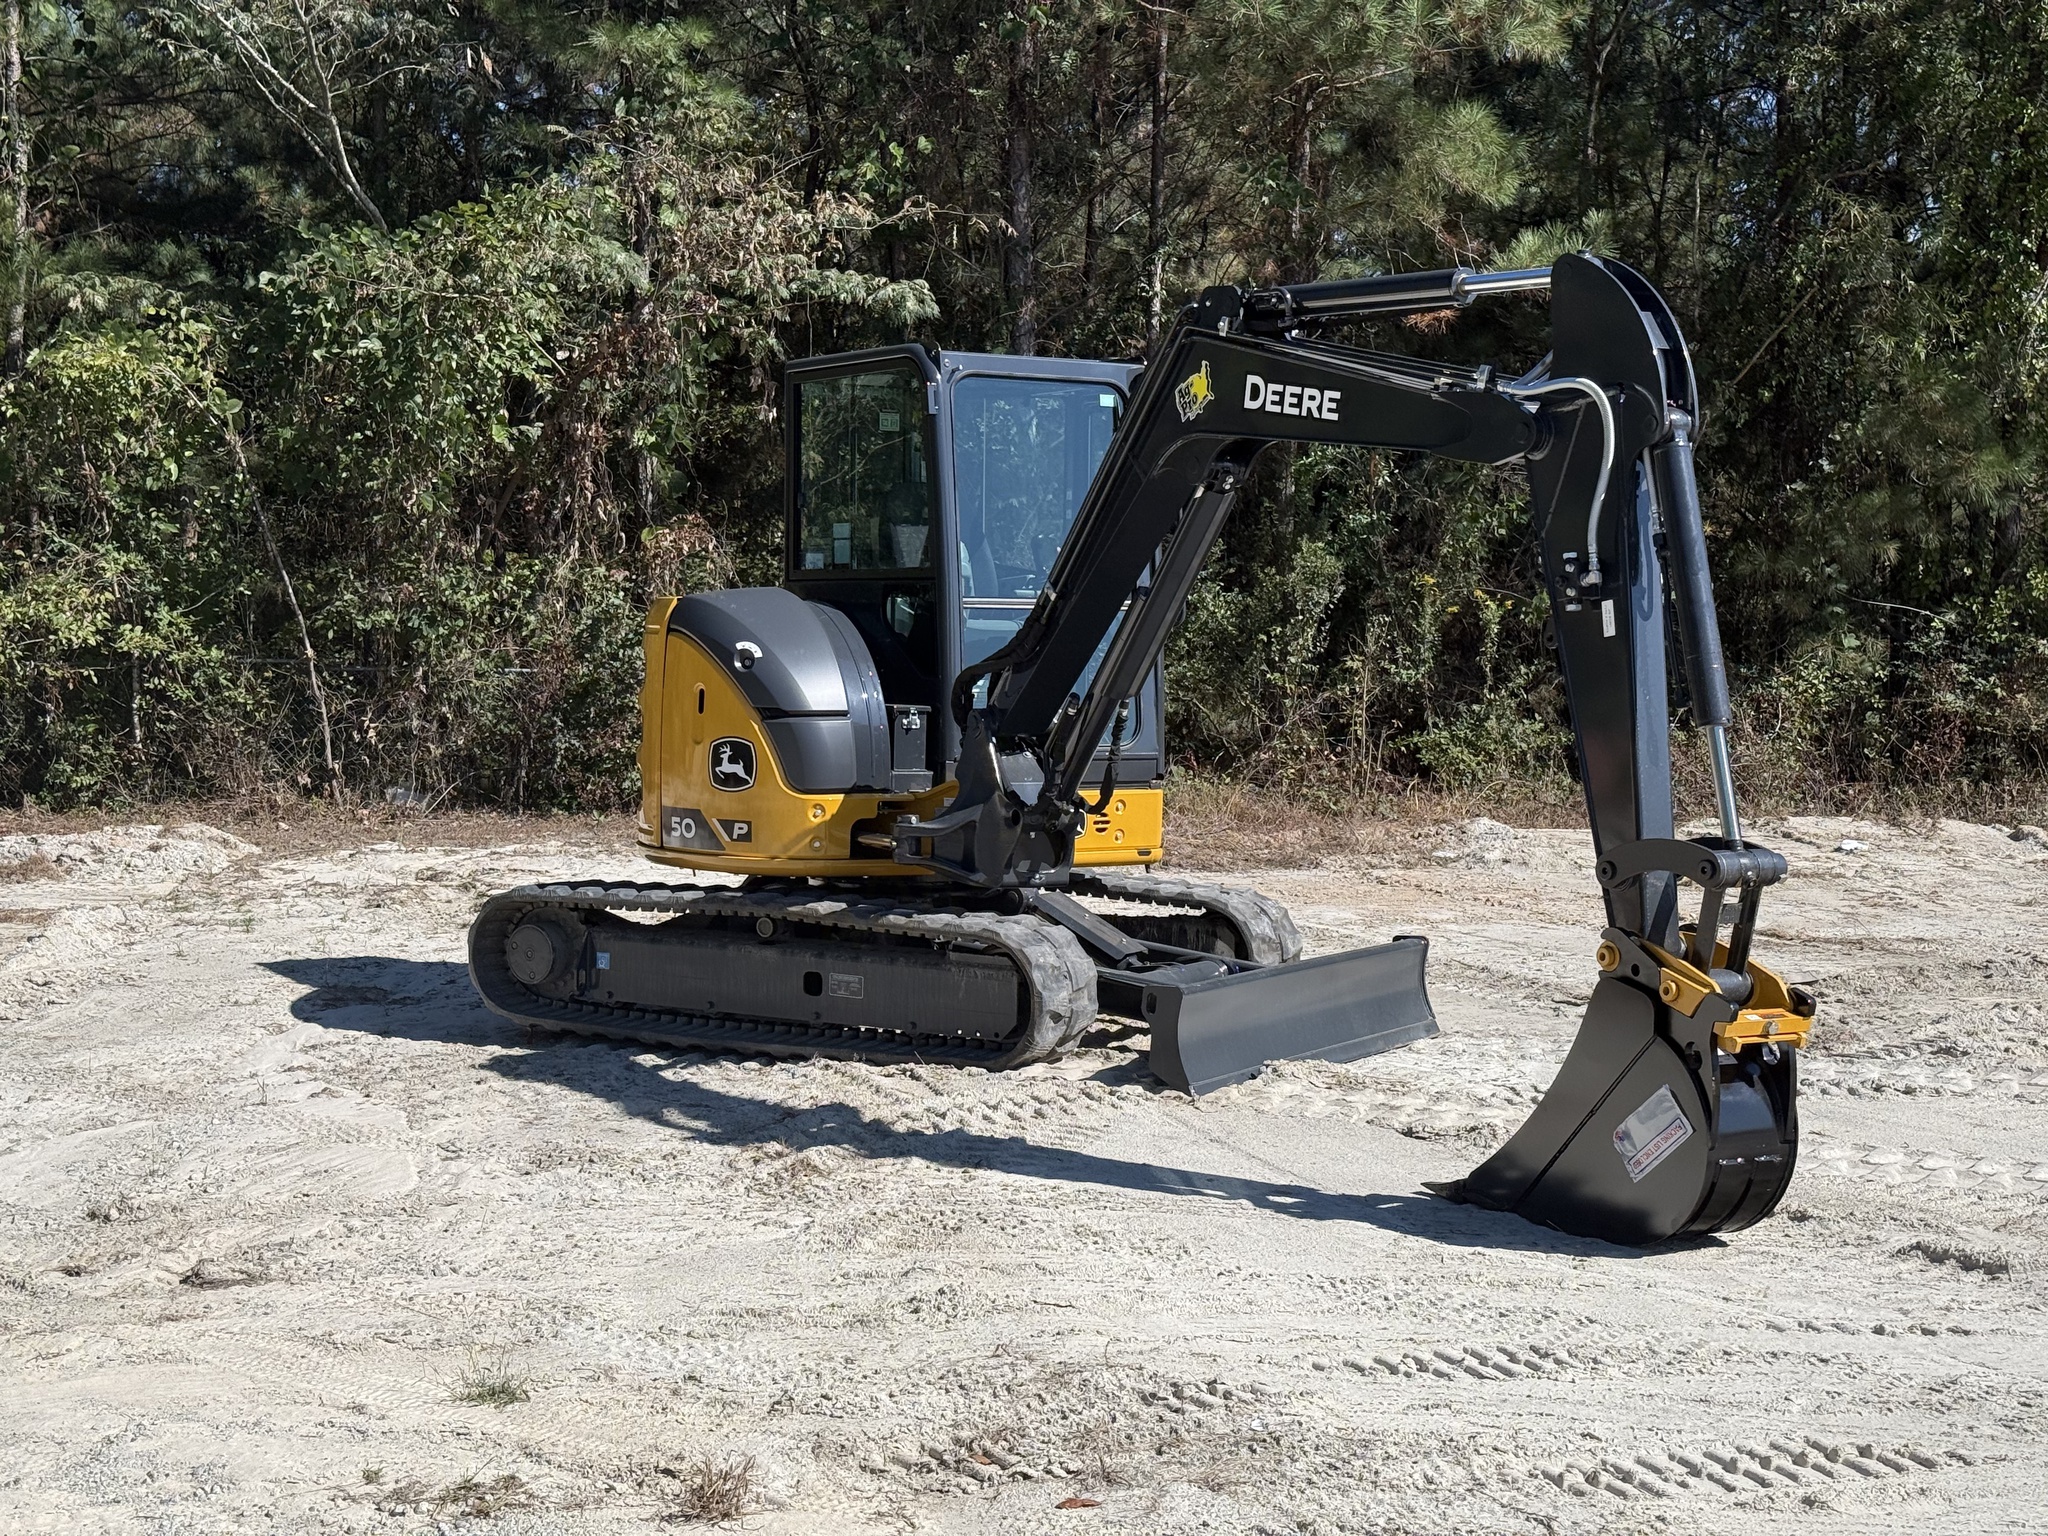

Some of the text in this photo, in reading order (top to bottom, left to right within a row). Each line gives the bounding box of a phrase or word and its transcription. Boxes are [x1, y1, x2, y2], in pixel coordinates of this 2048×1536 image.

[1181, 392, 1198, 416] Pro
[1243, 374, 1341, 421] DEERE
[671, 816, 749, 839] 50 P
[1660, 1123, 1682, 1144] PACKING
[1651, 1140, 1663, 1152] LIST
